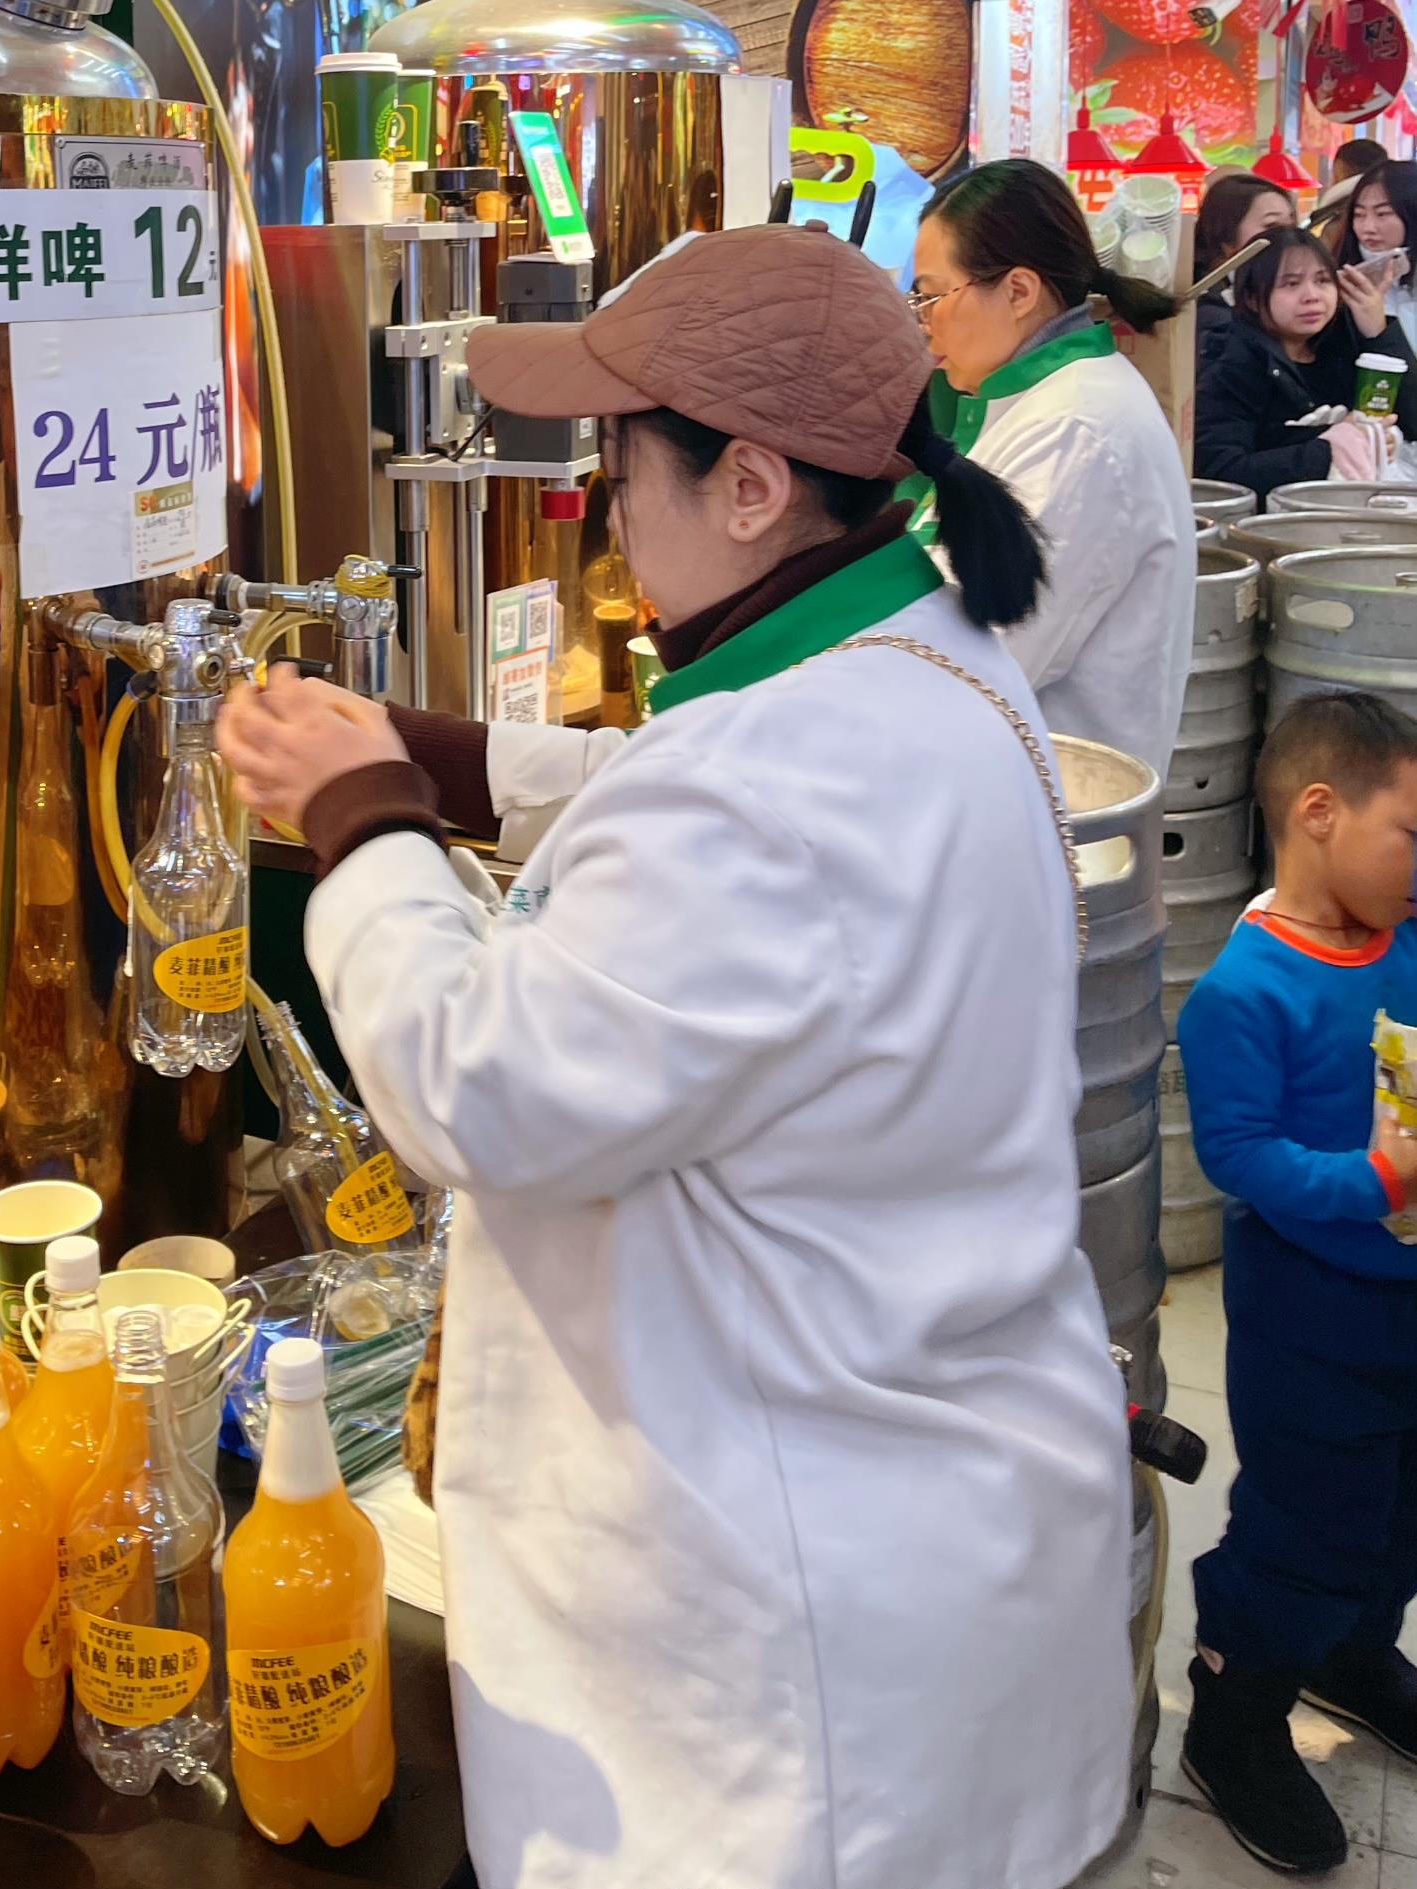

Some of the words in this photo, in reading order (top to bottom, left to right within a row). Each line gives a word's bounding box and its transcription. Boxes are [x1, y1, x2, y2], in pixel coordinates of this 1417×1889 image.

[134, 204, 217, 299] 12元
[33, 407, 117, 489] 24
[169, 955, 231, 977] 麦菲精酿
[115, 1645, 199, 1682] 纯粮酿造
[285, 1648, 370, 1708] 纯粮酿造
